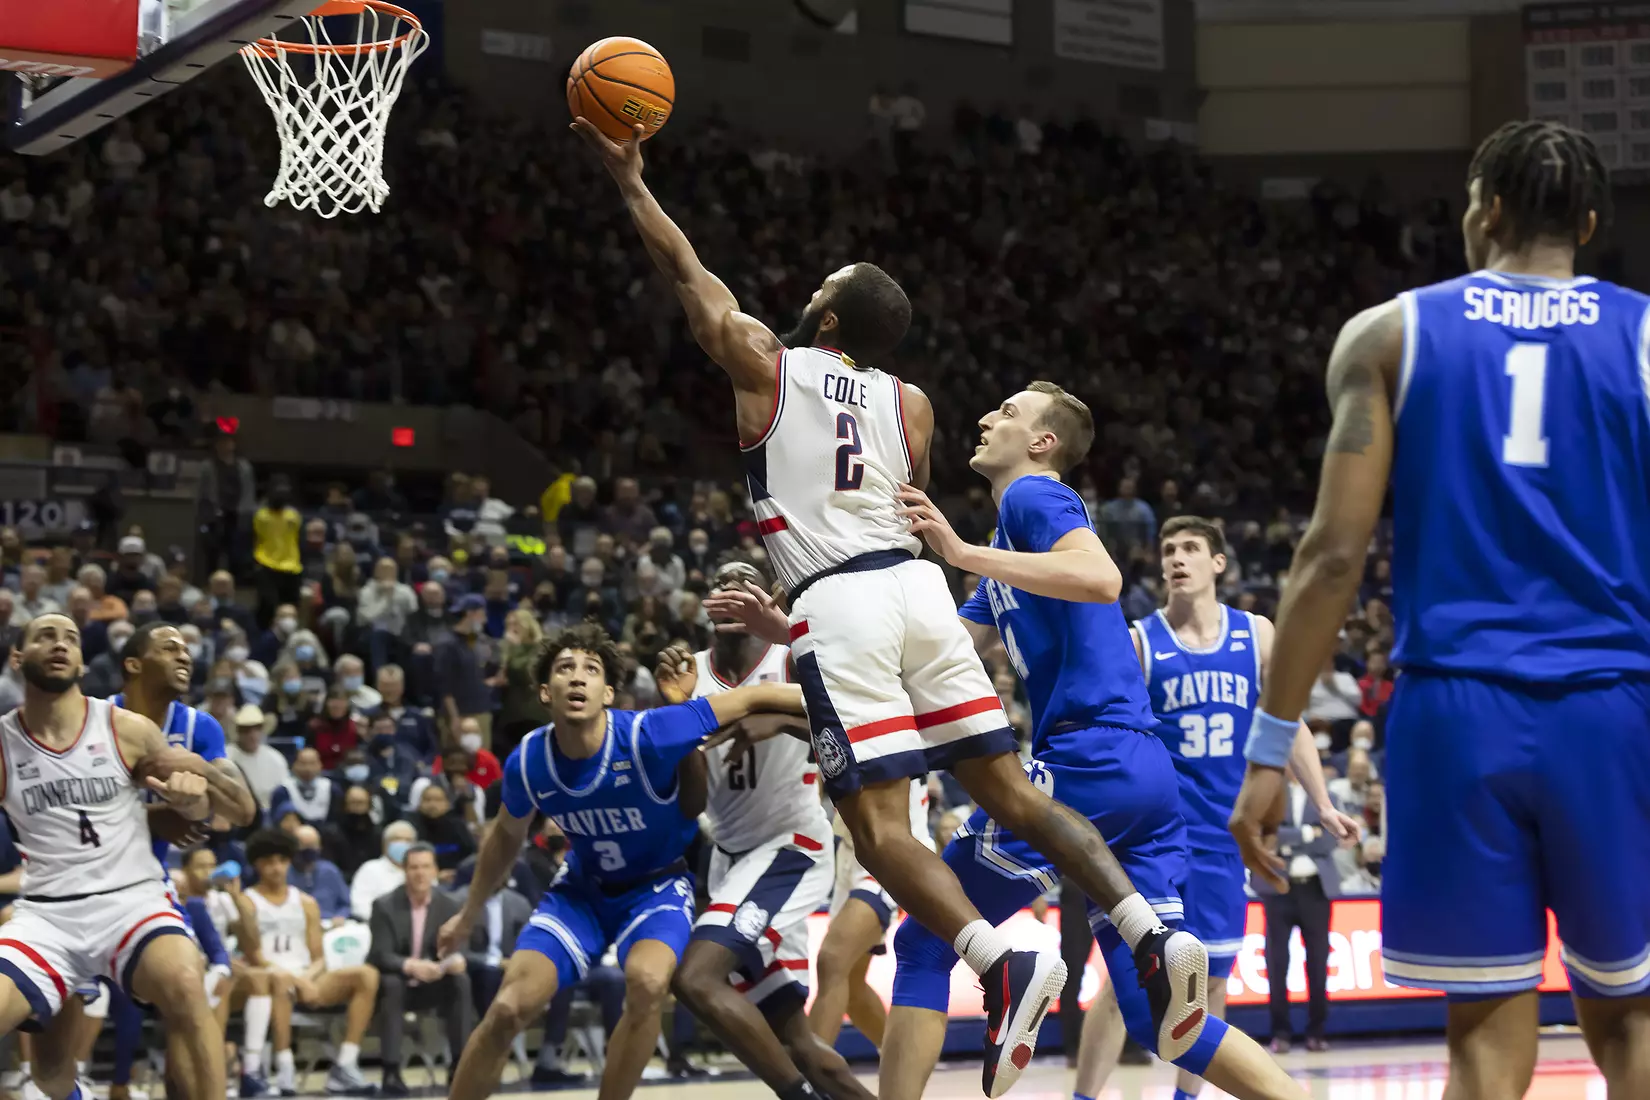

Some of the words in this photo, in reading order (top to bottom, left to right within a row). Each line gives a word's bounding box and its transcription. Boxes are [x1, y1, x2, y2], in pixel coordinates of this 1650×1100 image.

[620, 98, 667, 127] ELITE
[1463, 285, 1601, 330] SCRUGGS
[823, 373, 868, 410] COLE
[1503, 341, 1551, 469] 1
[834, 412, 865, 491] 2
[2, 501, 63, 530] 120
[1161, 669, 1250, 714] XAVIER
[1178, 712, 1235, 759] 32
[79, 809, 101, 848] 4
[551, 806, 648, 837] XAVIER
[592, 840, 627, 872] 3
